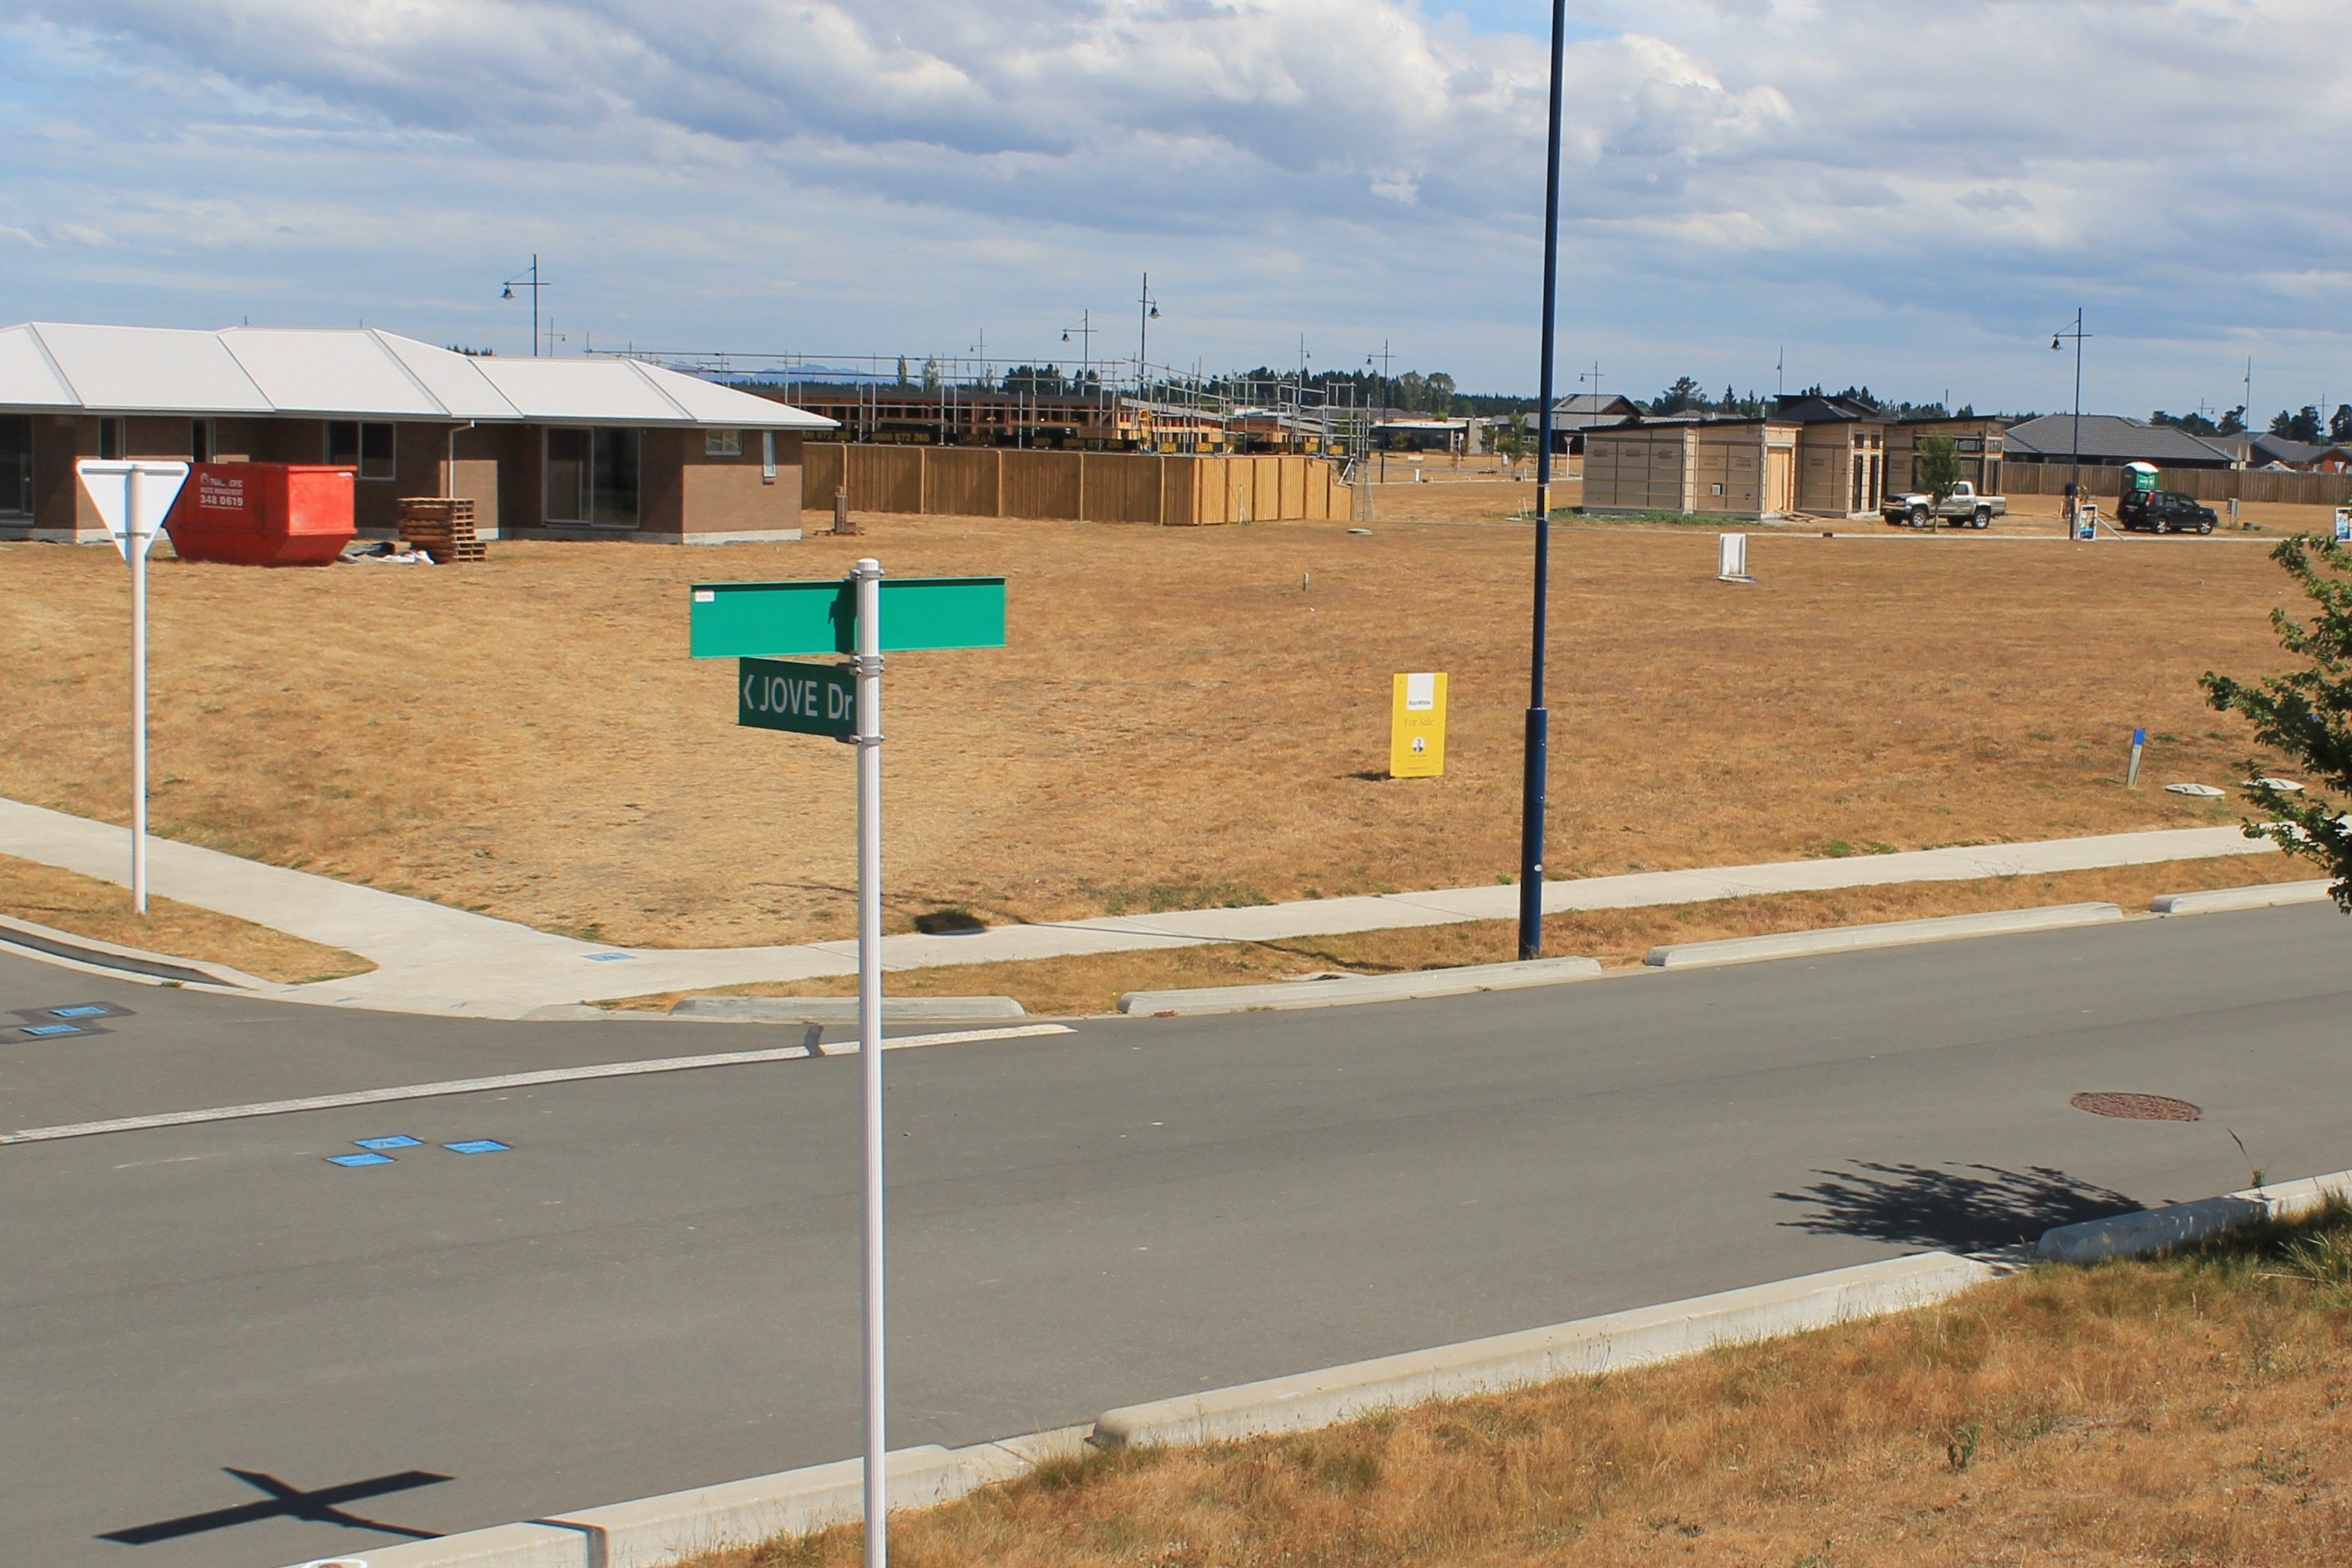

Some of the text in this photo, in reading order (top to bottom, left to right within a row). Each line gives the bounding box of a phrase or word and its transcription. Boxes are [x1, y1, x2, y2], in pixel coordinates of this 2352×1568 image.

[894, 433, 911, 442] 872
[958, 434, 996, 444] URBAN
[200, 494, 243, 506] 348 0619
[759, 676, 853, 720] JOVE Dr
[1404, 716, 1434, 726] For Sale
